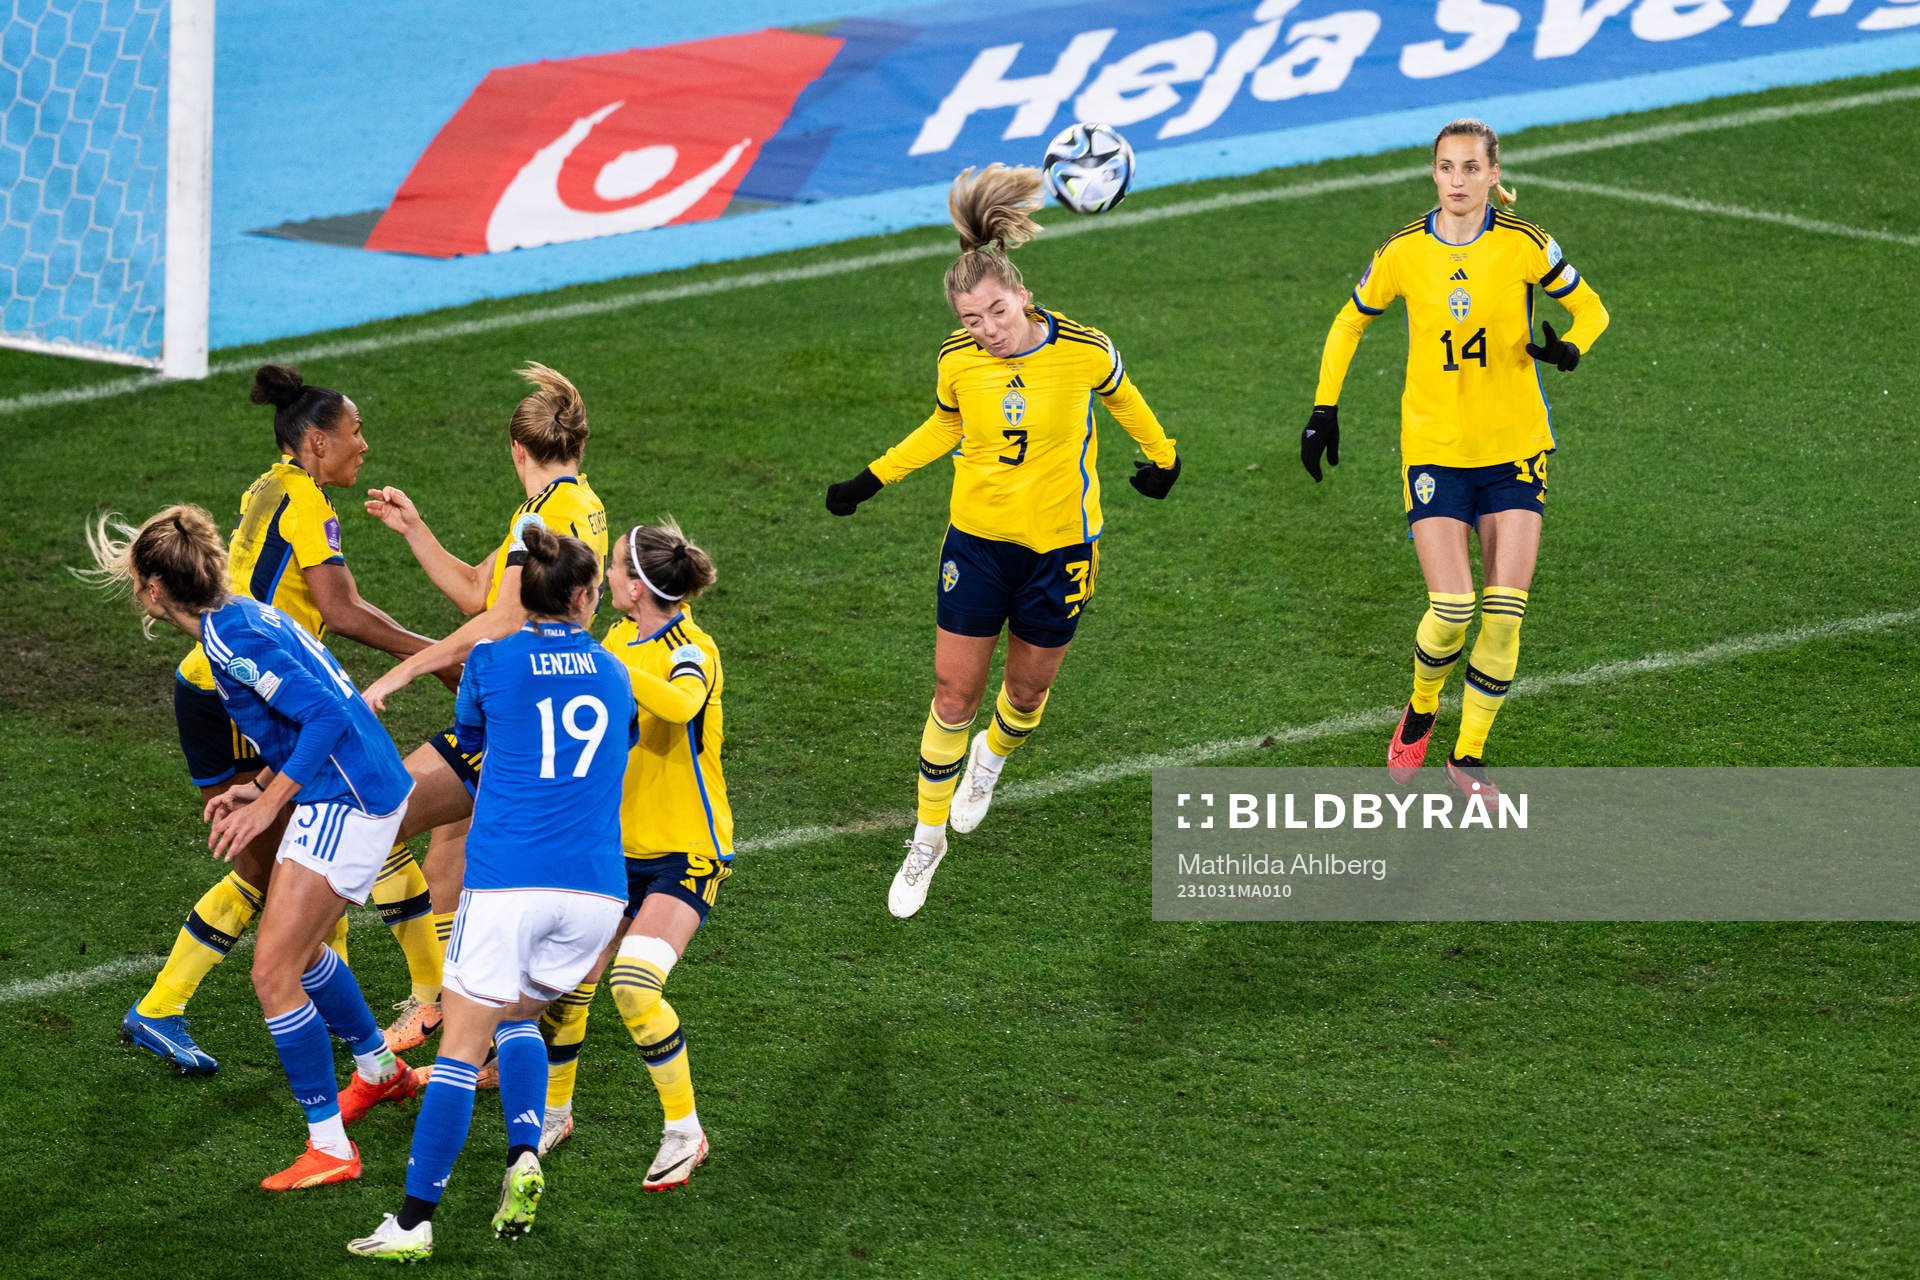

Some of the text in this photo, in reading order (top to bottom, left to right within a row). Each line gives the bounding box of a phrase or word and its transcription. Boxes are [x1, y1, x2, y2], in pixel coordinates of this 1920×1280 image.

[909, 0, 1382, 157] Heja
[1440, 327, 1487, 372] 14
[998, 429, 1029, 466] 3
[1064, 560, 1090, 605] 3
[543, 628, 566, 638] ITALIA
[529, 652, 599, 677] LENZINI
[535, 694, 609, 779] 19
